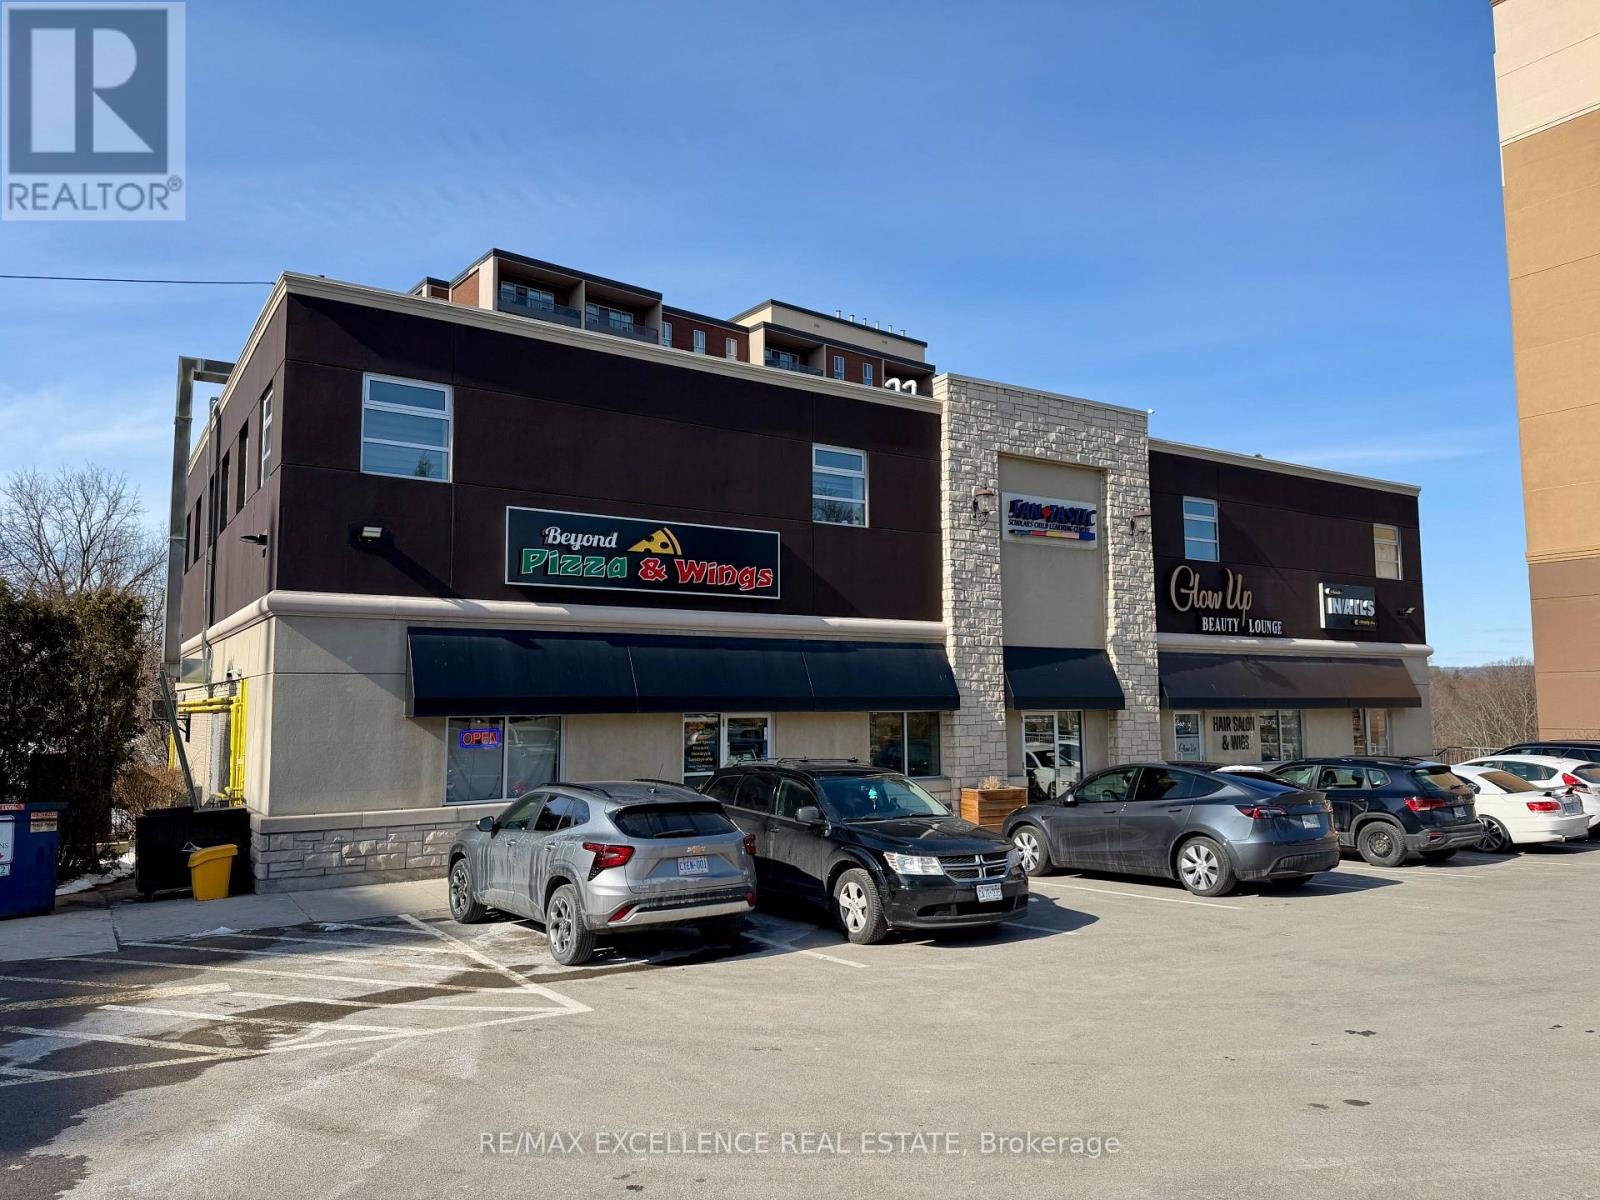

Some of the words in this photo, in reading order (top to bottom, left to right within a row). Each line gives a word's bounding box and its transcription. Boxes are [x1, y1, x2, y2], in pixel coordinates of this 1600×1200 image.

[545, 527, 617, 550] Beyond
[521, 548, 628, 578] Pizza
[638, 557, 668, 581] &
[674, 558, 774, 592] Wings
[1170, 565, 1223, 612] Glow
[1226, 568, 1252, 627] Up
[1202, 616, 1240, 634] BEAUTY
[1249, 618, 1283, 635] LOUNGE
[1212, 716, 1232, 732] HAIR
[1232, 716, 1255, 731] SALON
[463, 732, 498, 745] OPEN
[1222, 734, 1230, 751] &
[1231, 735, 1250, 750] WIGS
